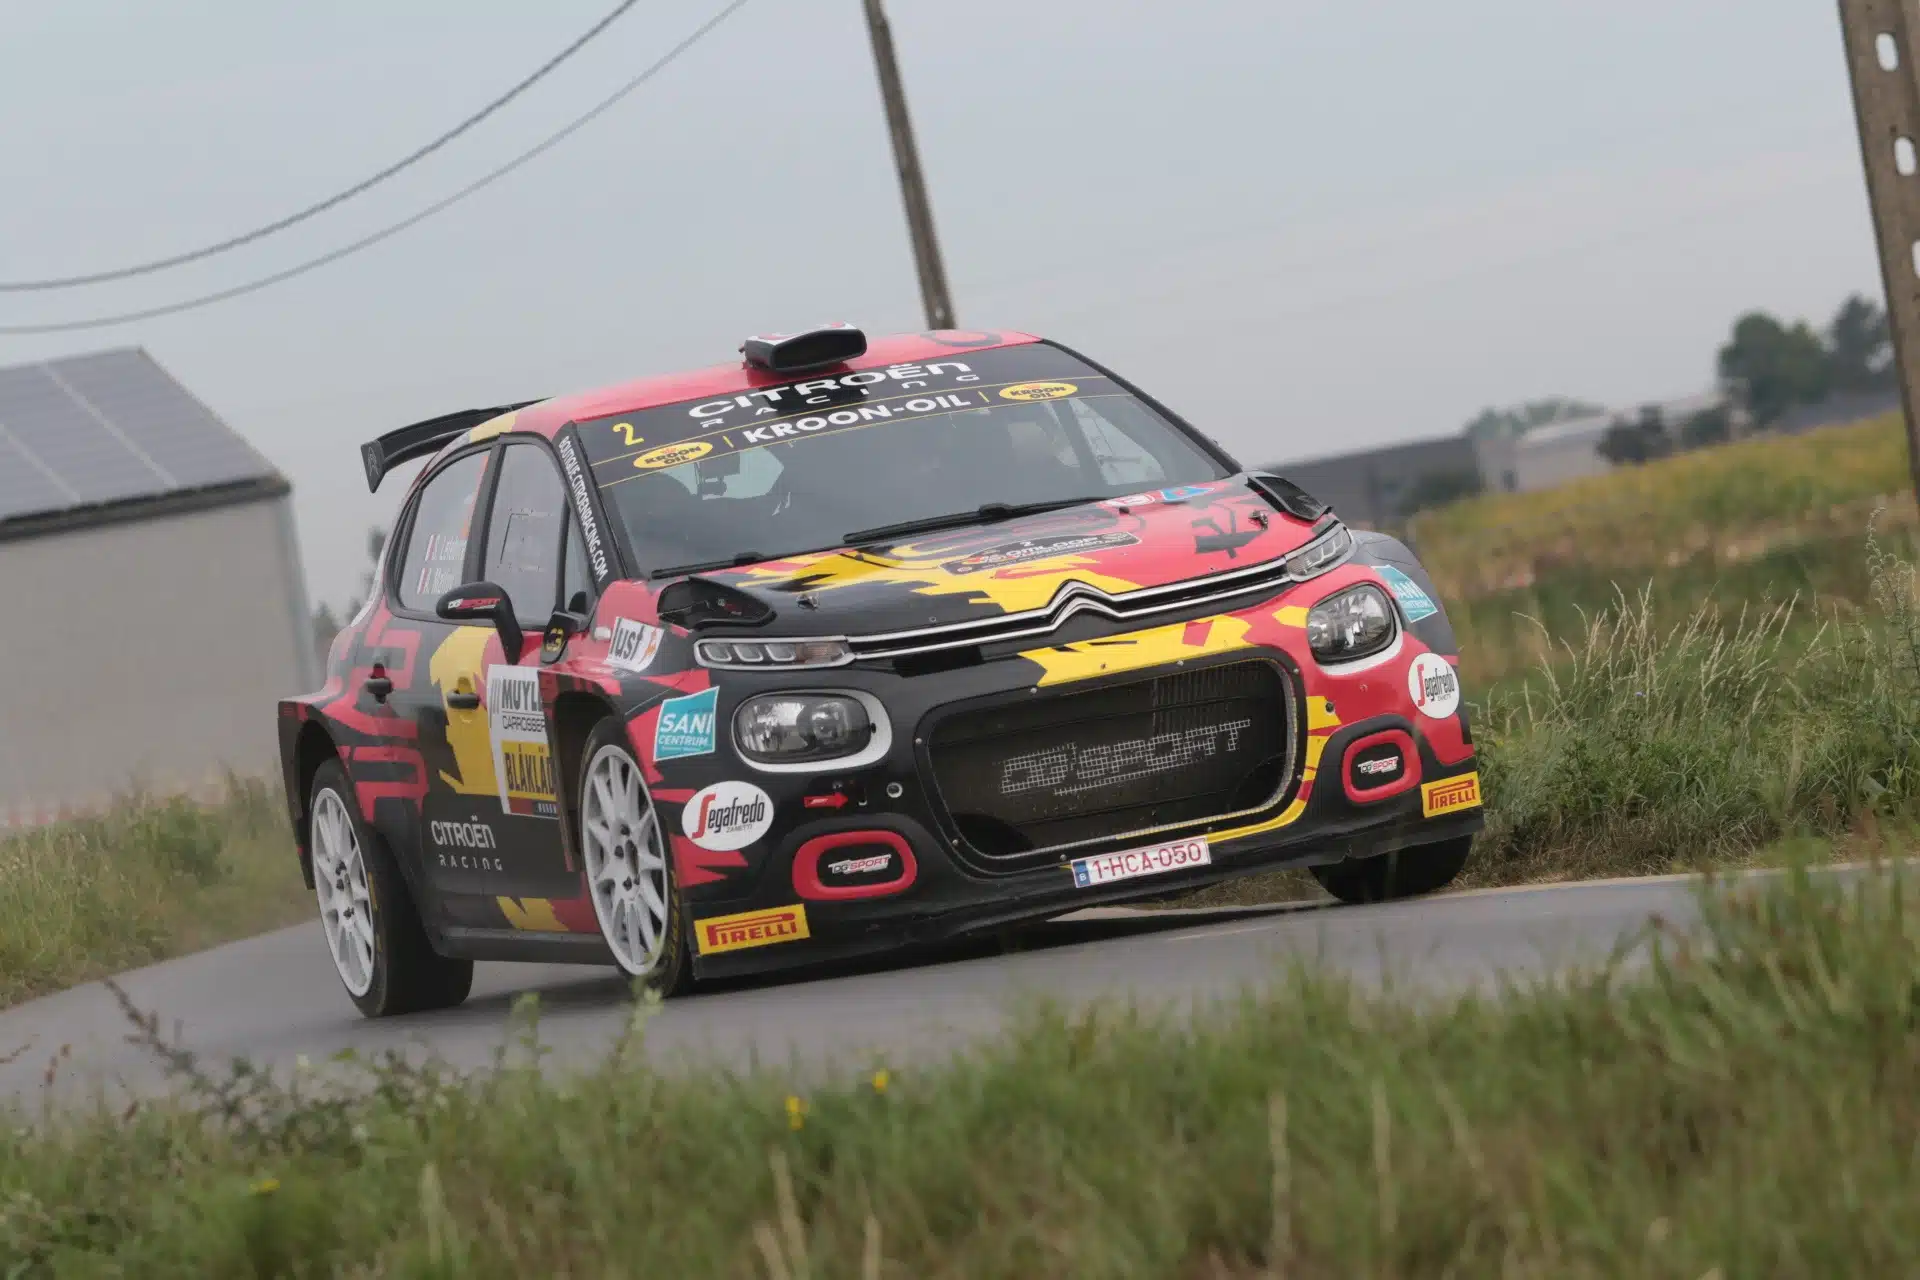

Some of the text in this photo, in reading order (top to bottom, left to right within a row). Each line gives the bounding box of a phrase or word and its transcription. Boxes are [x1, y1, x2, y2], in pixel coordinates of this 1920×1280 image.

[689, 362, 972, 418] CITROËN
[700, 374, 980, 428] RACING
[1009, 385, 1067, 397] KROON
[1028, 391, 1054, 400] OIL
[612, 423, 644, 446] 2
[742, 394, 972, 443] KROON-OIL
[643, 445, 702, 465] KROON
[664, 455, 690, 465] OIL
[558, 436, 608, 582] BOUTIQUE.CITROENRACING.COM
[1416, 663, 1455, 707] Segafredo
[660, 712, 713, 735] SANI
[658, 735, 709, 746] CENTRUM
[1429, 779, 1476, 811] PIRELLI
[691, 791, 766, 839] Segafredo
[431, 814, 497, 849] CITROËN
[439, 854, 503, 871] RACING
[1078, 872, 1087, 882] B
[1092, 842, 1201, 880] 1-HCA-050
[706, 913, 798, 947] PIRELLI
